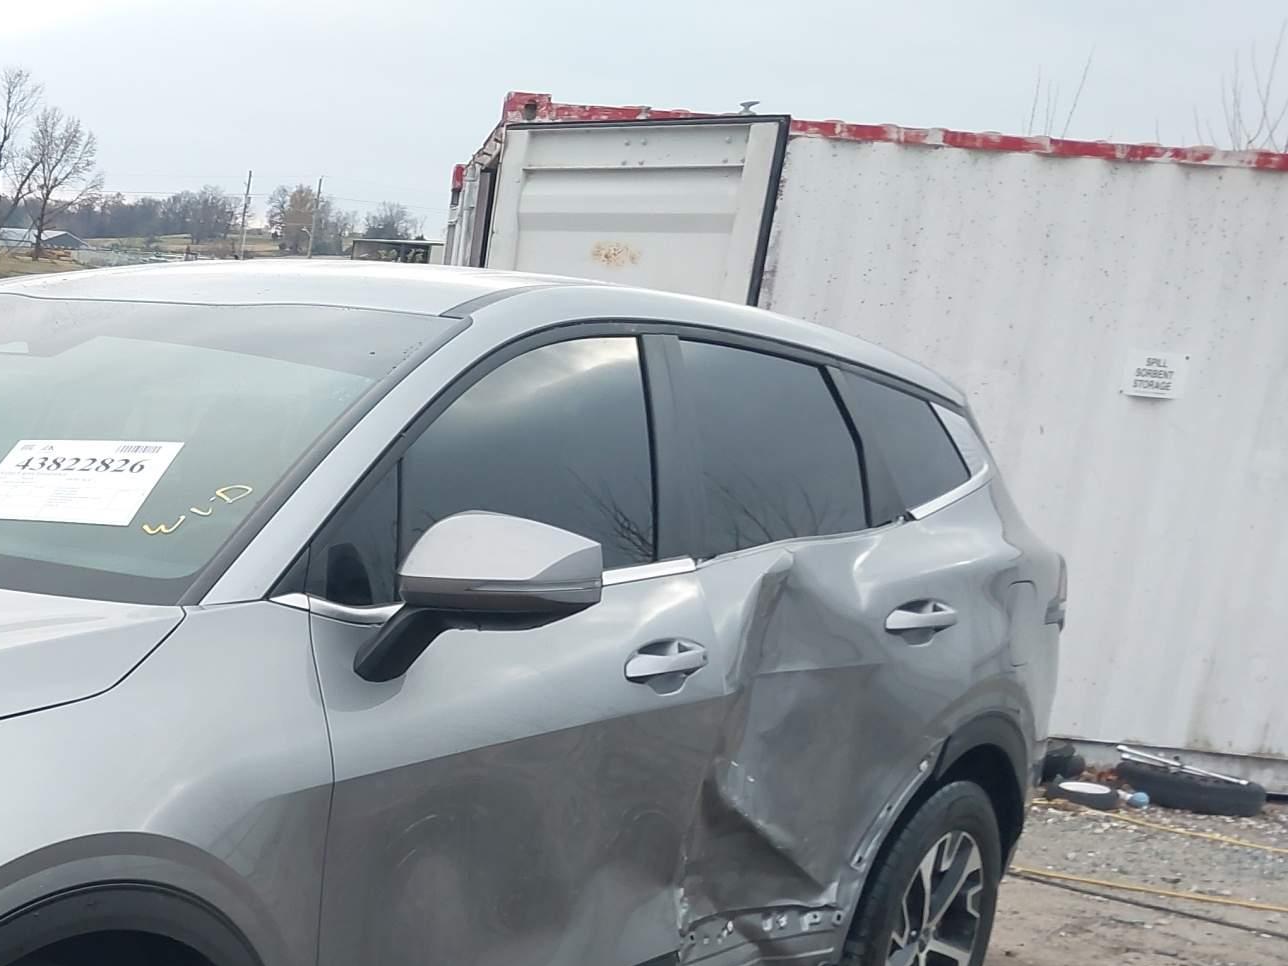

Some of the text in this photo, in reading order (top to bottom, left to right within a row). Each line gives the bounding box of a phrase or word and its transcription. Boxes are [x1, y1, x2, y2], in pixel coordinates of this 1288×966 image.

[1146, 357, 1168, 368] SPILL
[1135, 367, 1174, 379] SORBENT
[1133, 379, 1172, 391] STORAGE
[15, 456, 150, 474] 43822826
